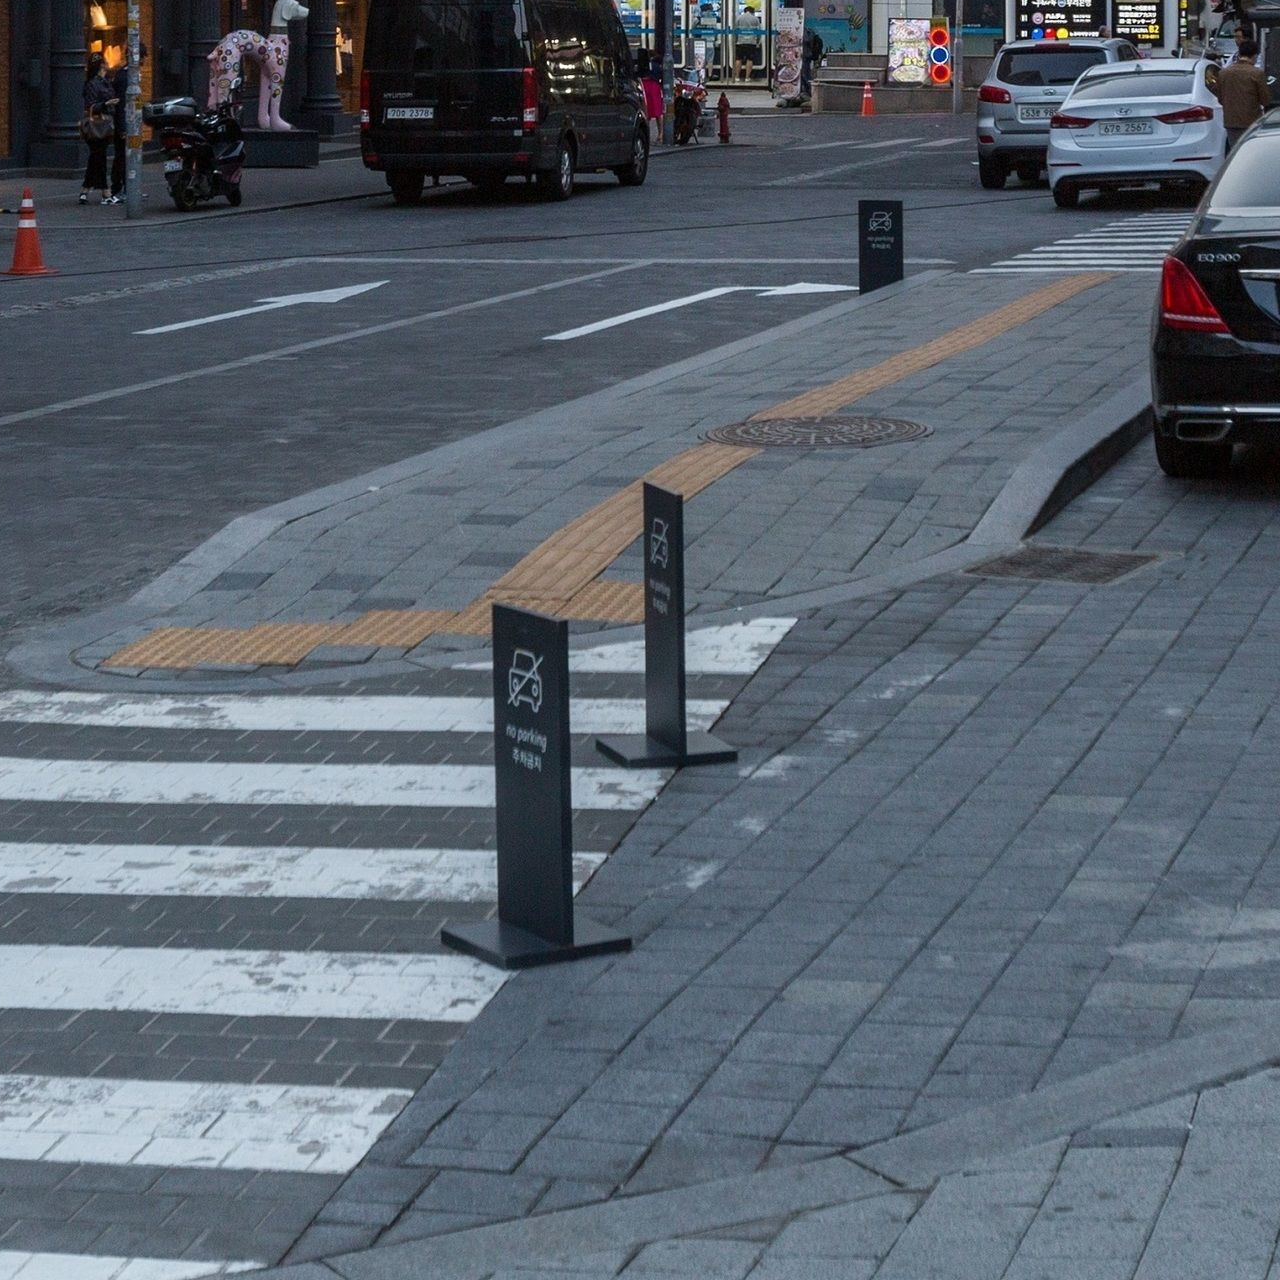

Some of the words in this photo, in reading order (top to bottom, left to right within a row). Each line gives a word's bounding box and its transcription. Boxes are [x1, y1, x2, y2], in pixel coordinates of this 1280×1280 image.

[1066, 0, 1092, 8] 우리은행
[1148, 25, 1159, 33] B2
[409, 109, 430, 118] 2378
[1125, 123, 1148, 133] 2567
[506, 723, 517, 739] no
[517, 728, 547, 753] parking
